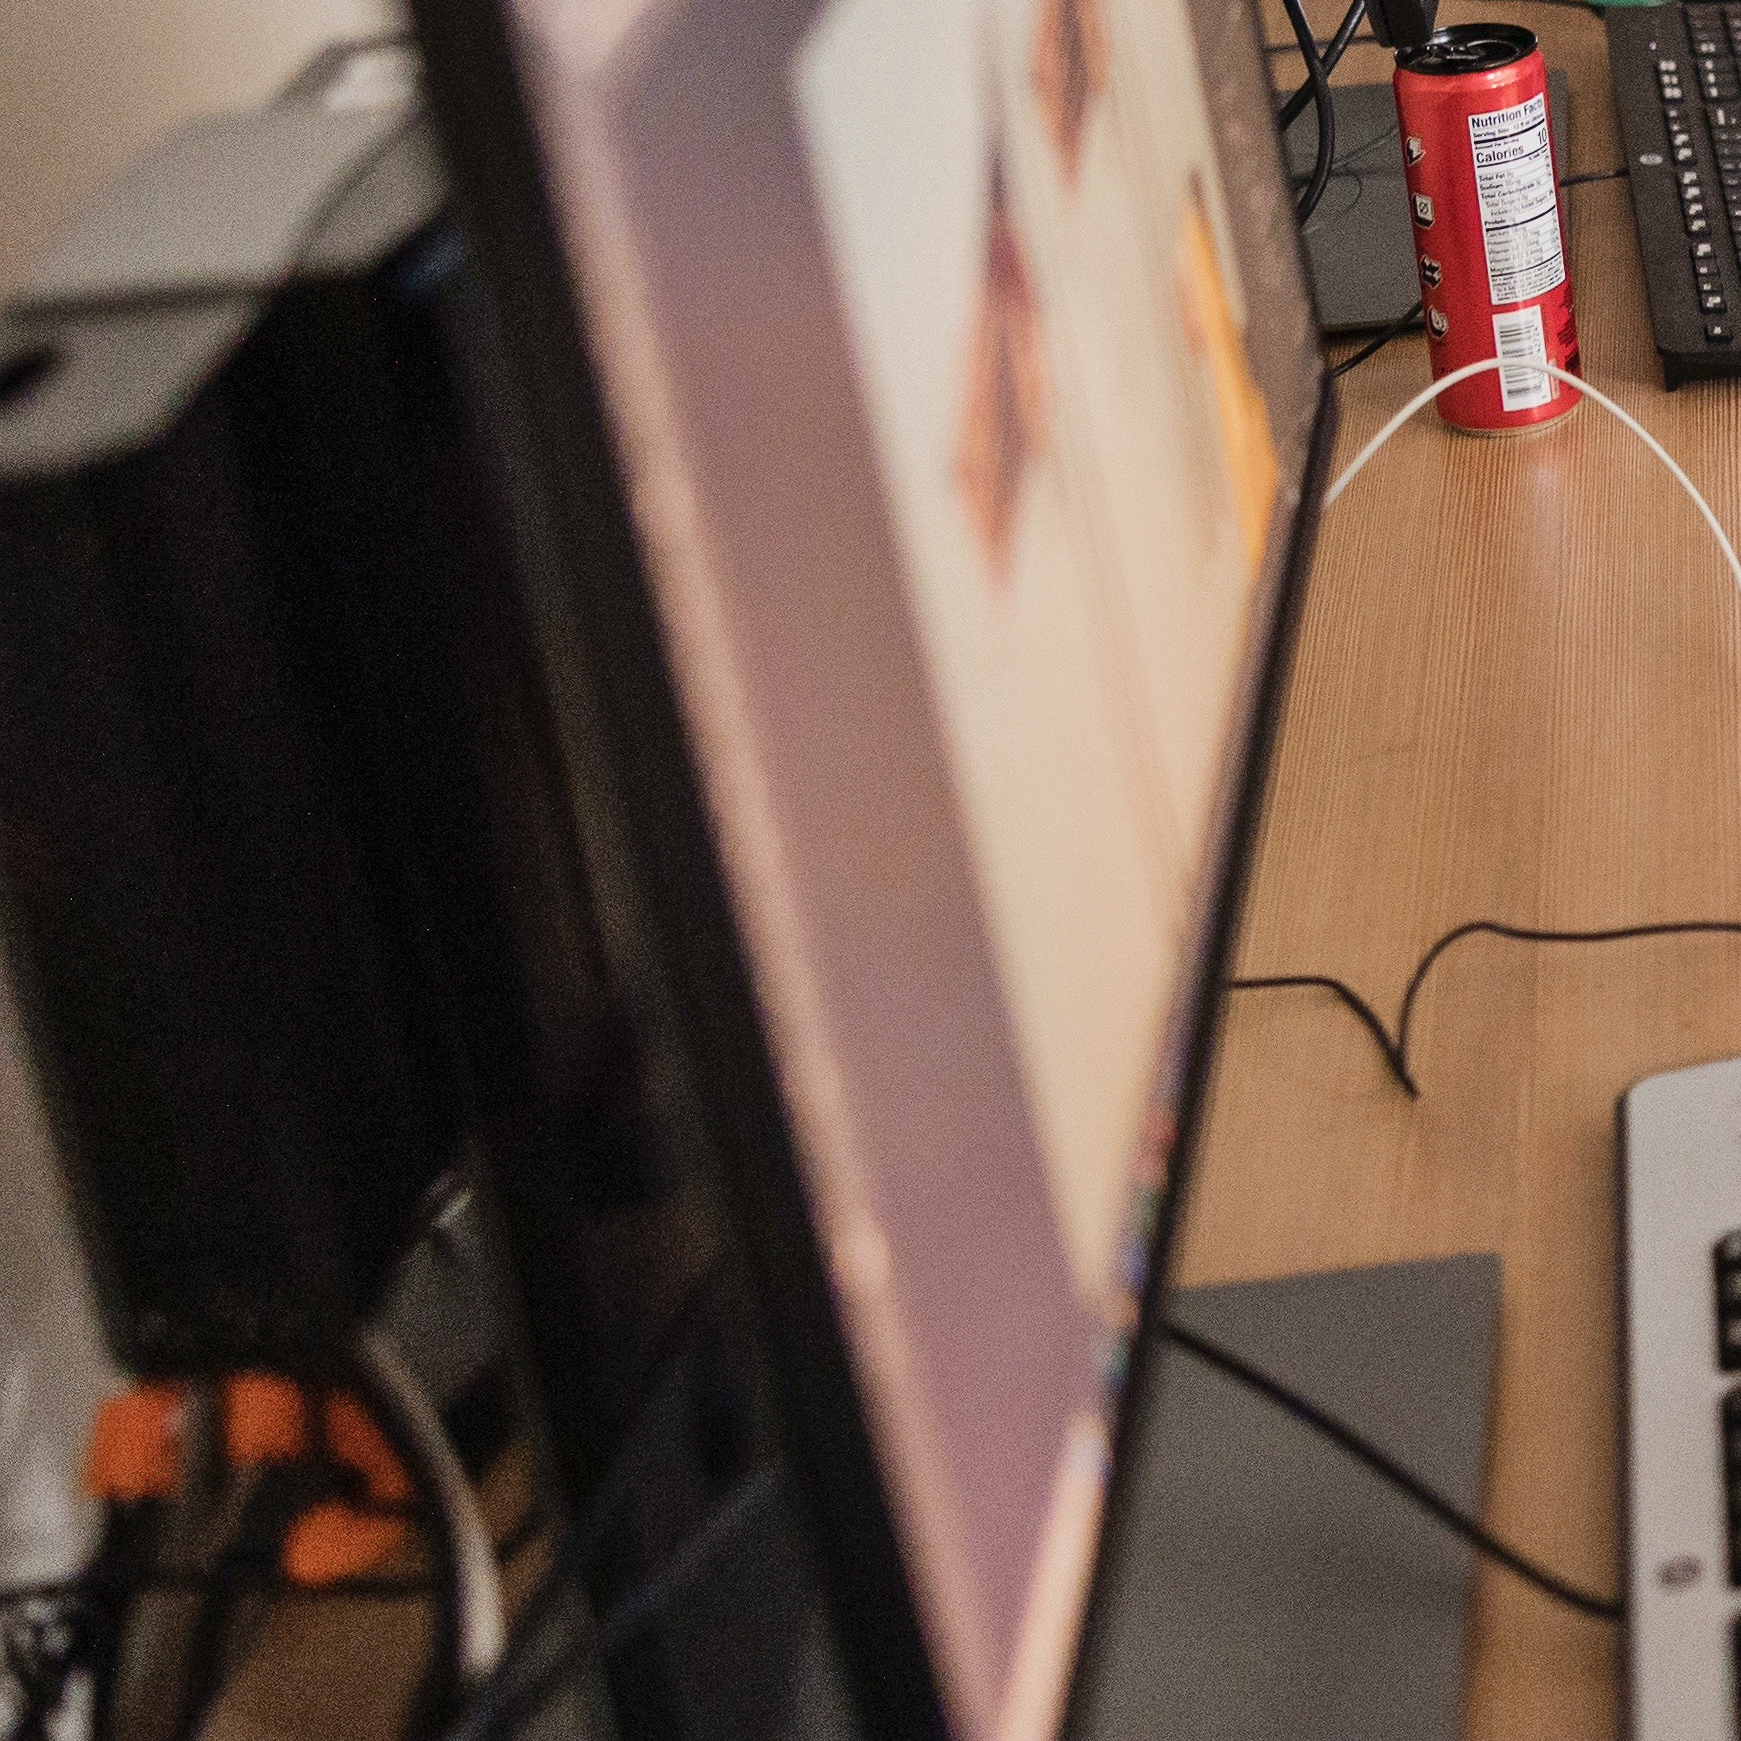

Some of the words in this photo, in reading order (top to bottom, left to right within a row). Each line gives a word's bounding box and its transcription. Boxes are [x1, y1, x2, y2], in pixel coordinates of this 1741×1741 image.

[1471, 110, 1521, 129] Nutrition
[1476, 145, 1524, 164] Calories
[1537, 127, 1547, 145] 10
